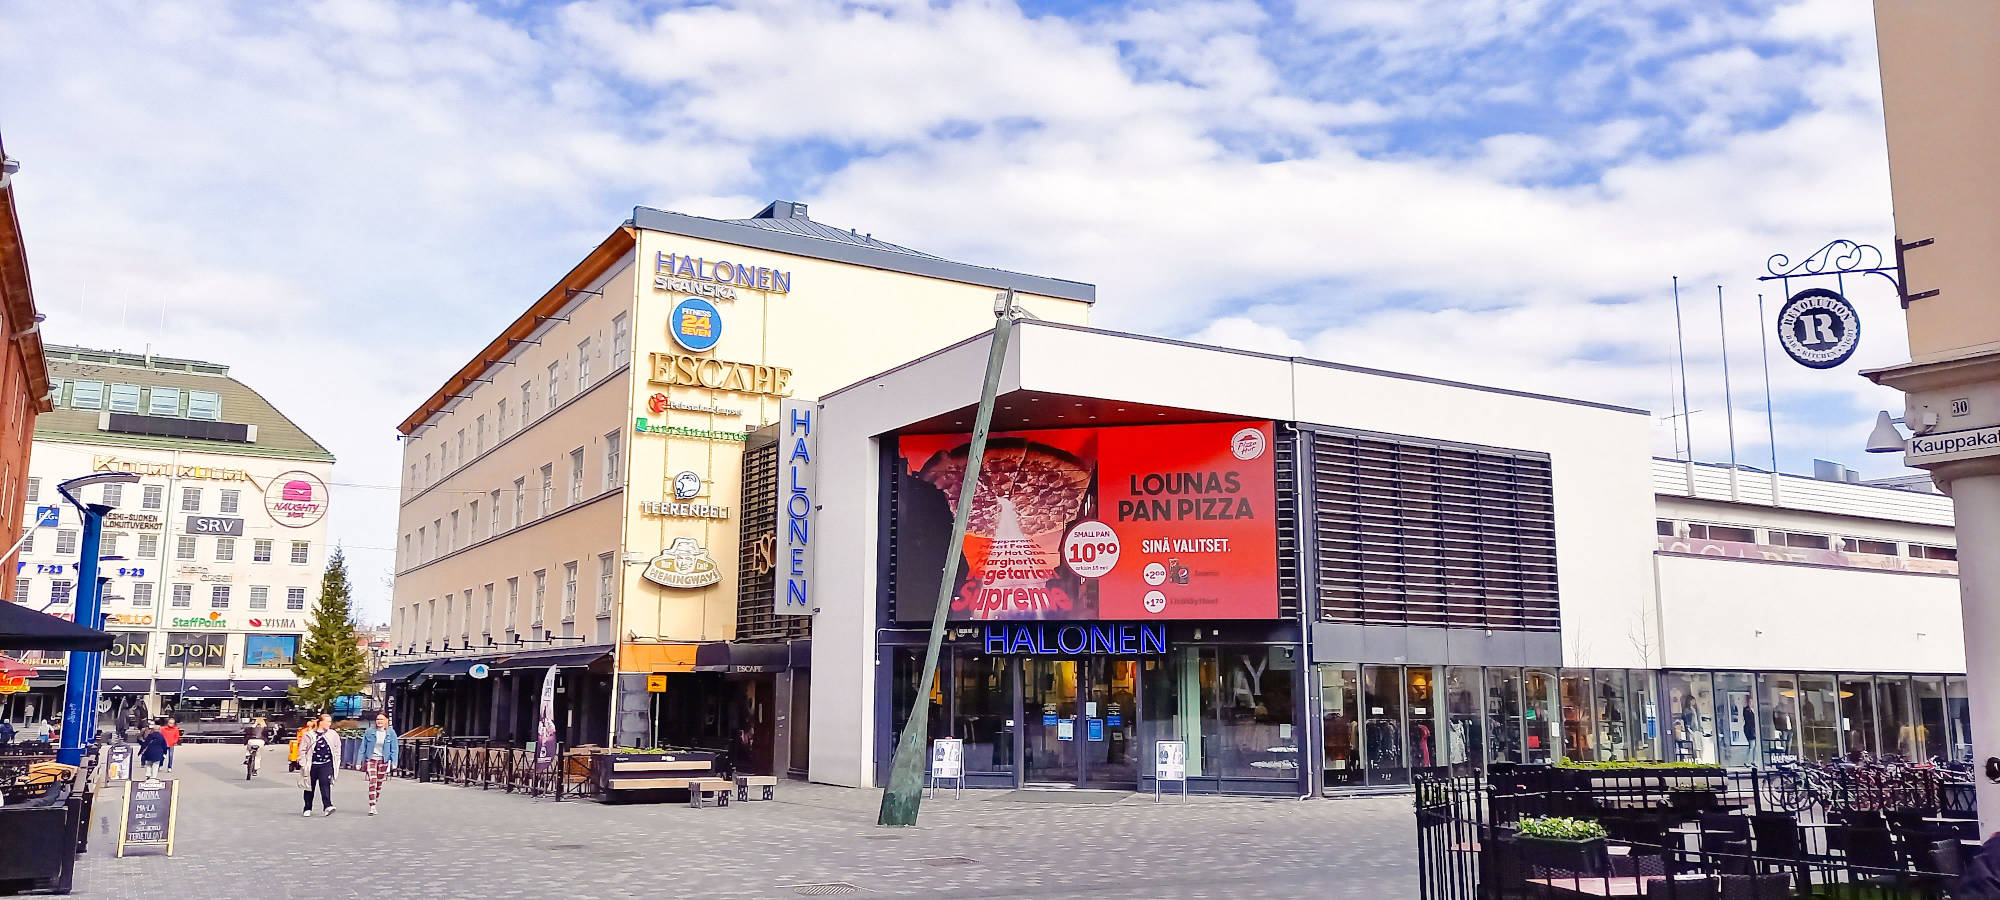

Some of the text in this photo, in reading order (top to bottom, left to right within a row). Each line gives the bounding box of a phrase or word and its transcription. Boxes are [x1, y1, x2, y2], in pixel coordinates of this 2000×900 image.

[656, 250, 792, 294] HALONEN
[654, 275, 737, 300] SKANSKA
[681, 307, 712, 318] FITNESS
[1783, 298, 1852, 326] REVOLUTION
[681, 313, 711, 330] 24
[1799, 313, 1839, 345] R
[680, 327, 712, 338] SEVEN
[648, 351, 794, 397] ESCAPE
[1952, 400, 1968, 414] 30
[1130, 470, 1241, 496] LOUNAS
[273, 502, 319, 514] NAUGHTY
[641, 500, 731, 520] TEERENPELI
[788, 408, 811, 605] HALONEN
[1118, 497, 1254, 523] PAN PIZZA
[196, 518, 235, 533] SRV
[1142, 537, 1231, 553] SINÄ VALITSET.
[976, 558, 1047, 568] Margherita
[119, 568, 145, 577] 9-23
[172, 617, 226, 628] StaffPoint
[265, 619, 296, 628] VISMA
[985, 625, 1166, 654] HALONEN
[169, 644, 224, 658] DON
